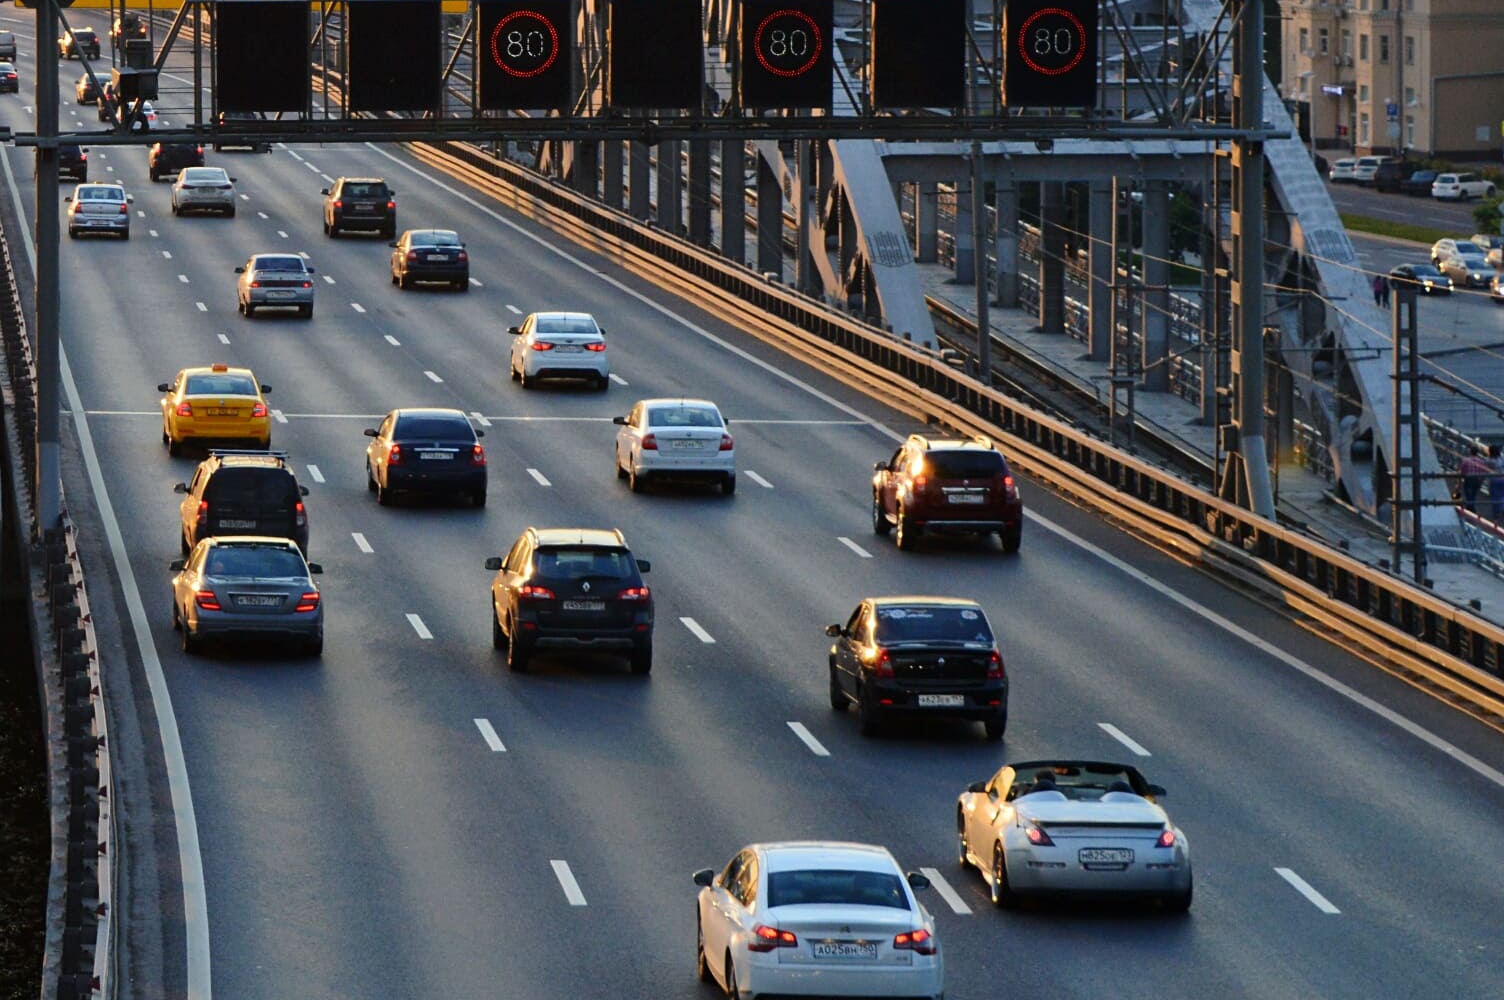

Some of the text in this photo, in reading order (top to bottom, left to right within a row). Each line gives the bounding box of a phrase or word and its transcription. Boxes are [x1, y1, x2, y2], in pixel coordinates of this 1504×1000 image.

[507, 31, 544, 58] 80
[770, 29, 807, 56] 80
[1034, 28, 1071, 55] 80
